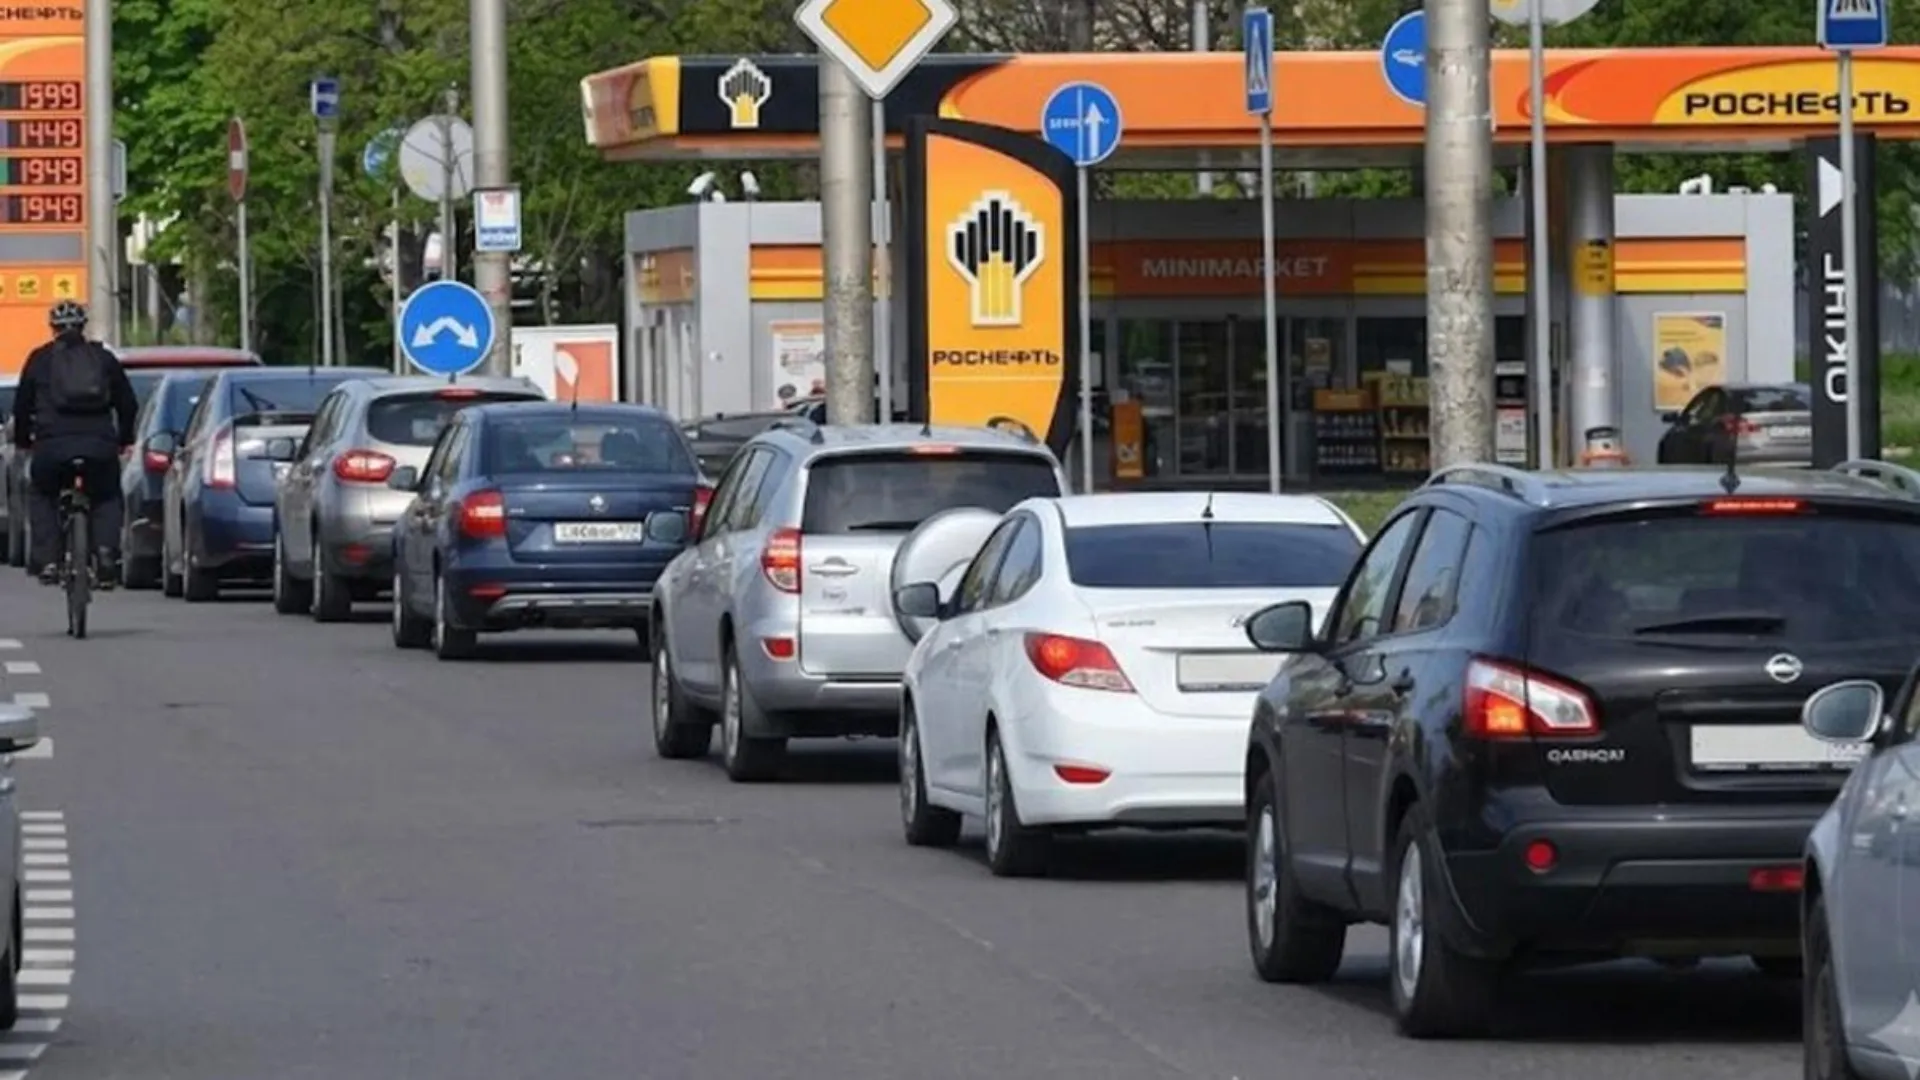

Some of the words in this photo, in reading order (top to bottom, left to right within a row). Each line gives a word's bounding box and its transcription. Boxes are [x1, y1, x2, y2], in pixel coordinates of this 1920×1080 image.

[1685, 92, 1910, 116] РОСНЕФТЬ
[20, 121, 78, 147] 1449
[21, 158, 78, 184] 1949
[21, 196, 78, 221] 1949
[932, 349, 1060, 365] РОСНЕФТЬ
